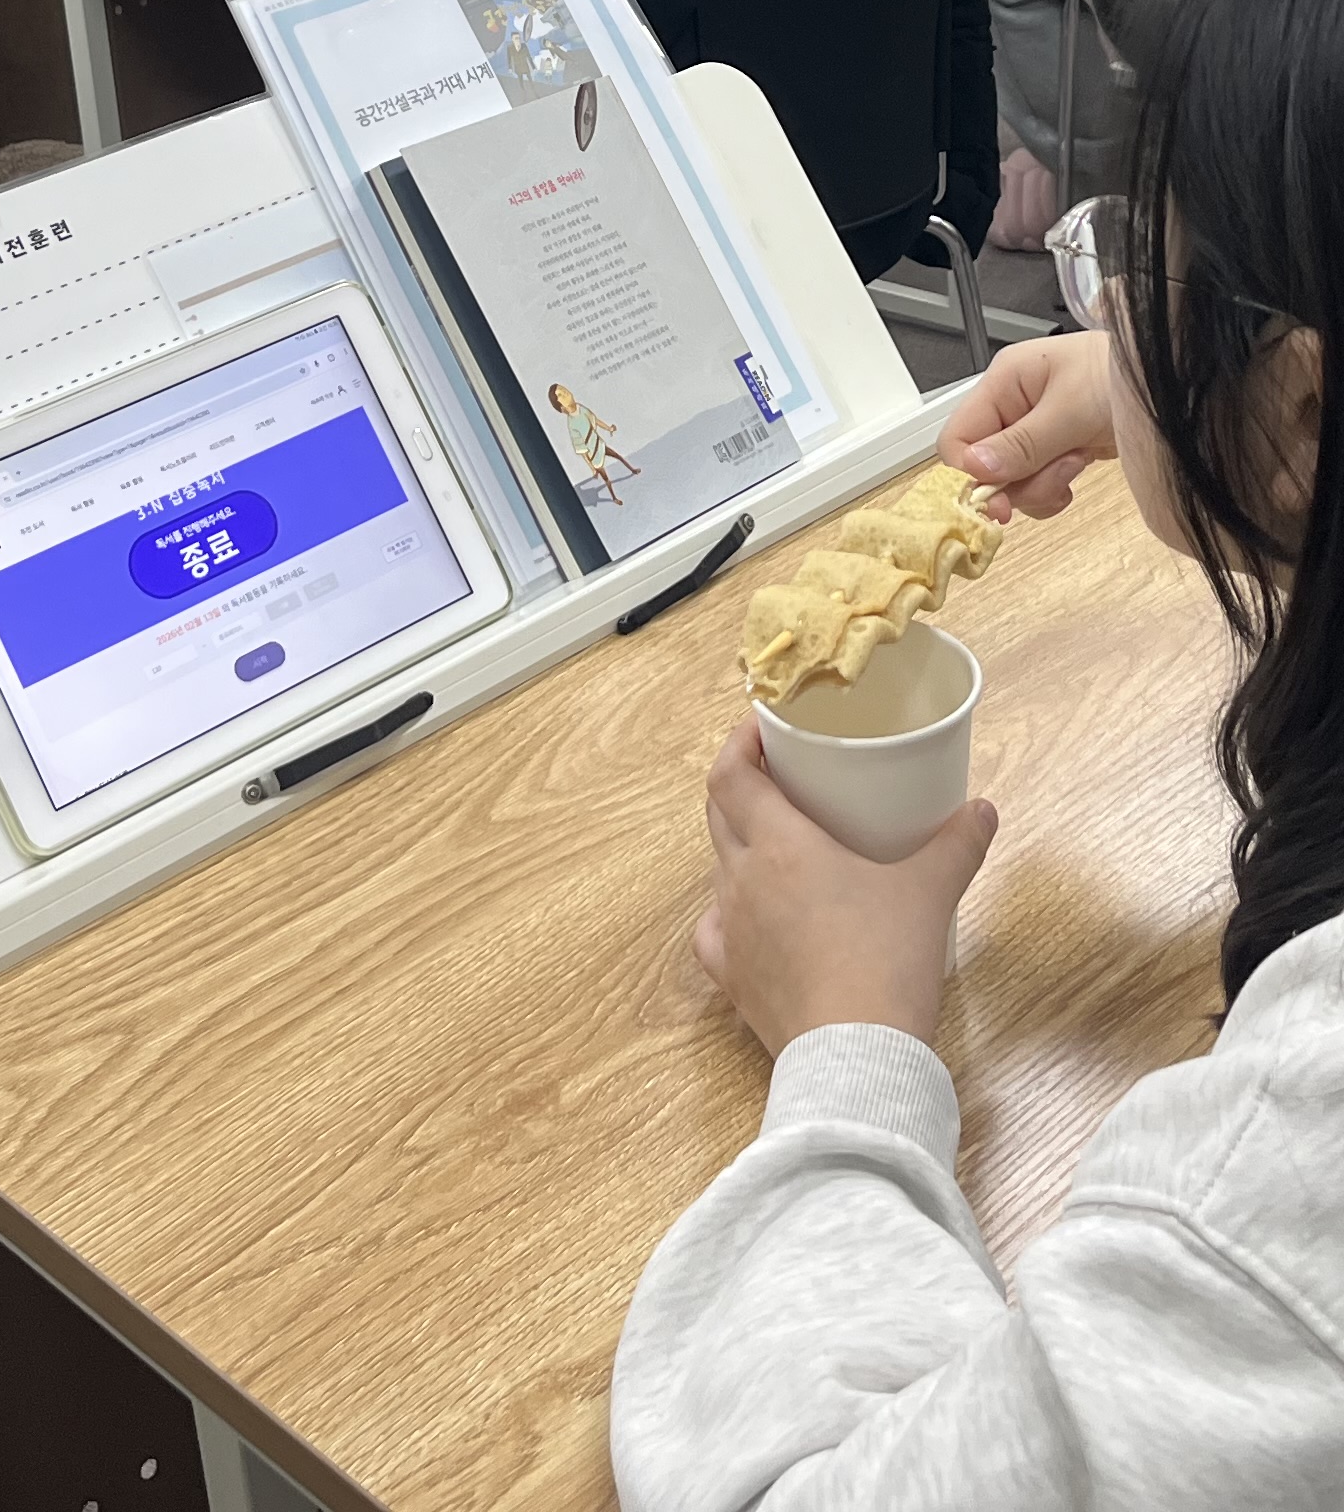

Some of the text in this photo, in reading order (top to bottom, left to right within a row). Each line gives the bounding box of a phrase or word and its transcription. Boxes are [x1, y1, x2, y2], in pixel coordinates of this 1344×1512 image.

[354, 62, 495, 129] 공간건설국과 거대 시계
[508, 189, 533, 206] 지구의
[180, 529, 240, 579] 종료
